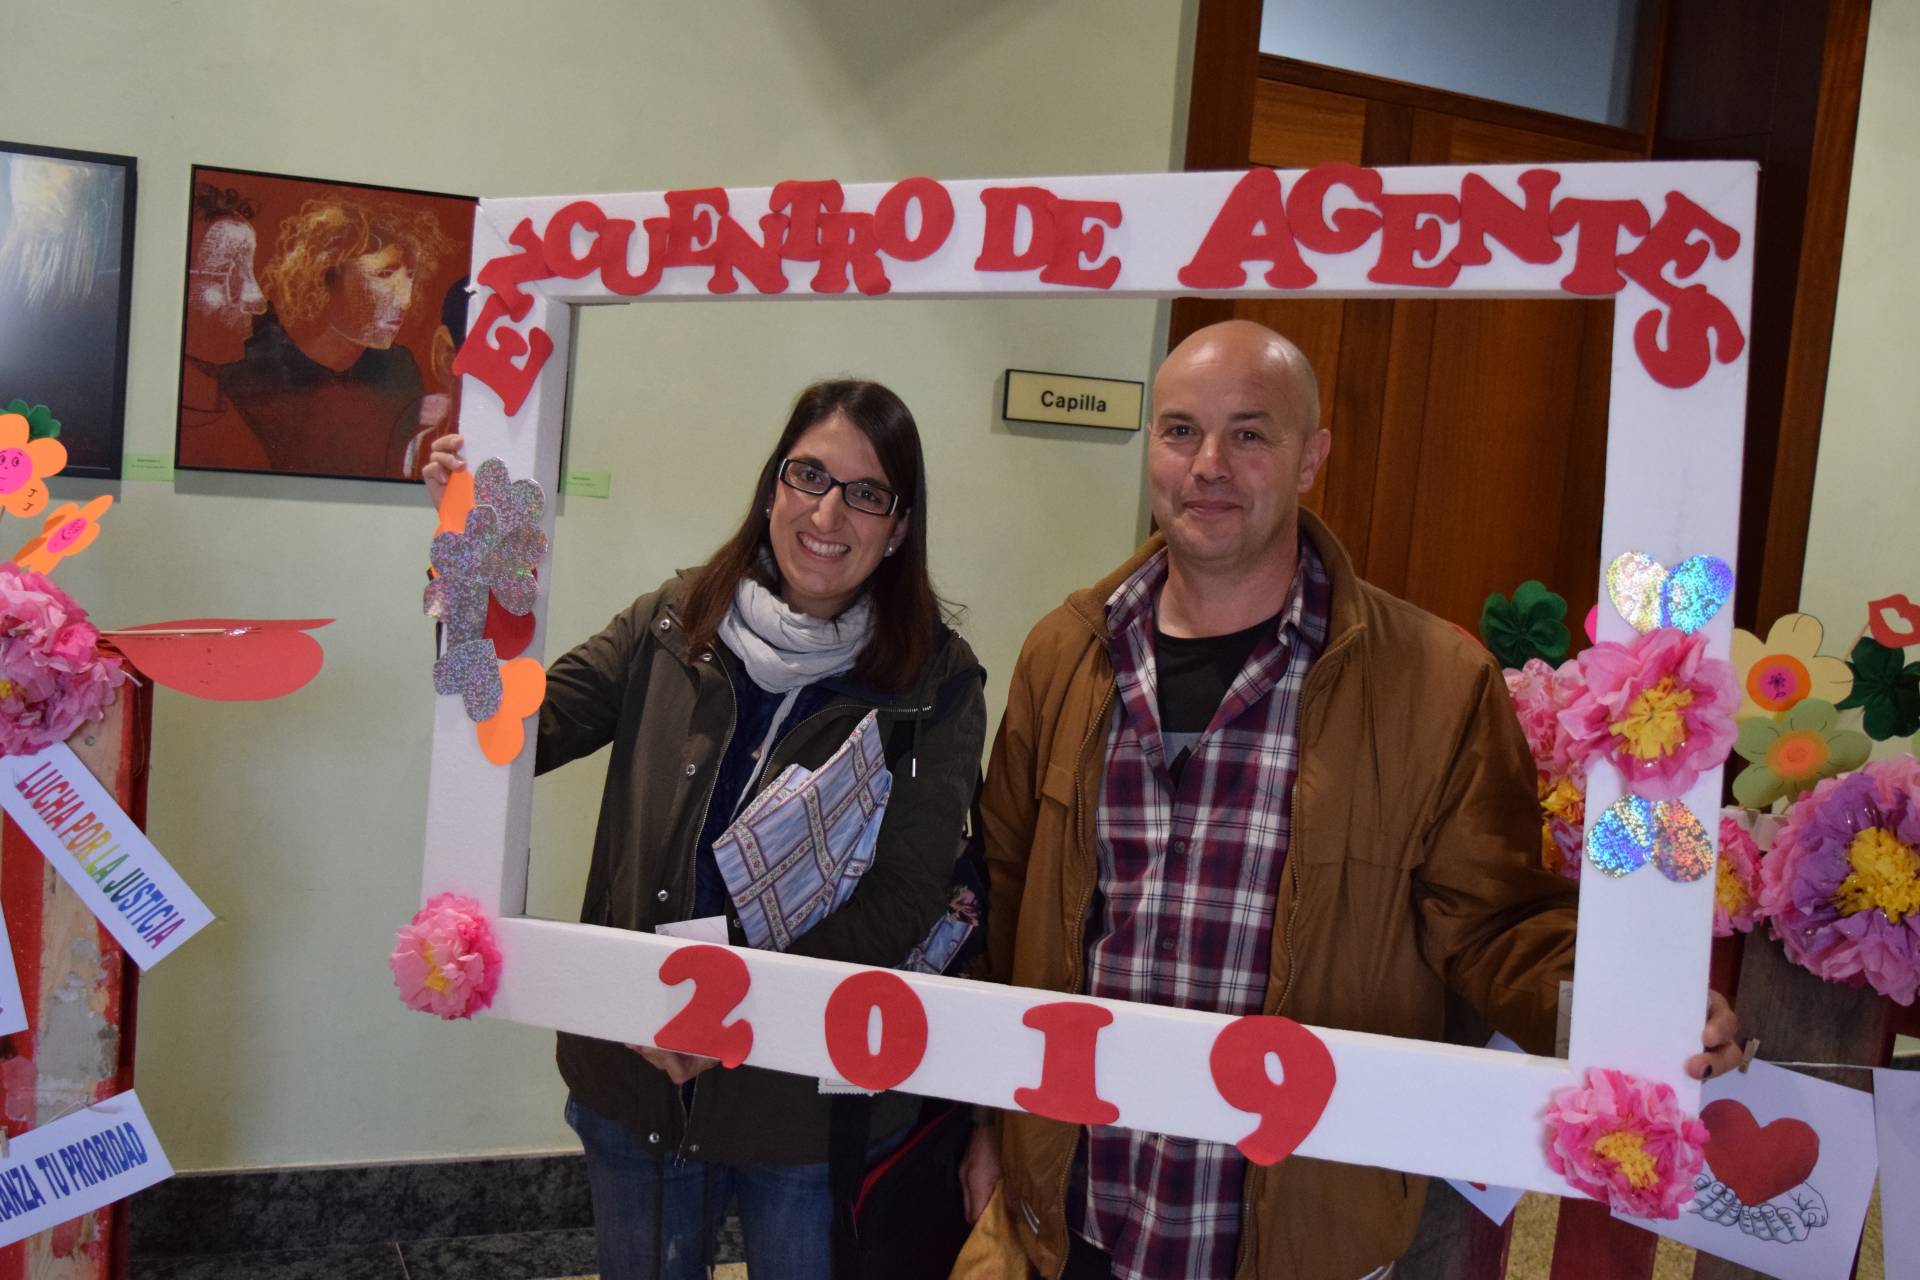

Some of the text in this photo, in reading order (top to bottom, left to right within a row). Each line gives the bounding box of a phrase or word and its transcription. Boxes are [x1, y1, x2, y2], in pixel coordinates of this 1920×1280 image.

[453, 162, 1745, 416] ENCUENTRO DE AGENTES
[1041, 390, 1107, 413] Capilla
[16, 761, 185, 949] LUCHA POR LA JUSTICIA
[653, 944, 1337, 1166] 2019
[0, 1121, 148, 1223] ANZA TU PRIORIDAD
